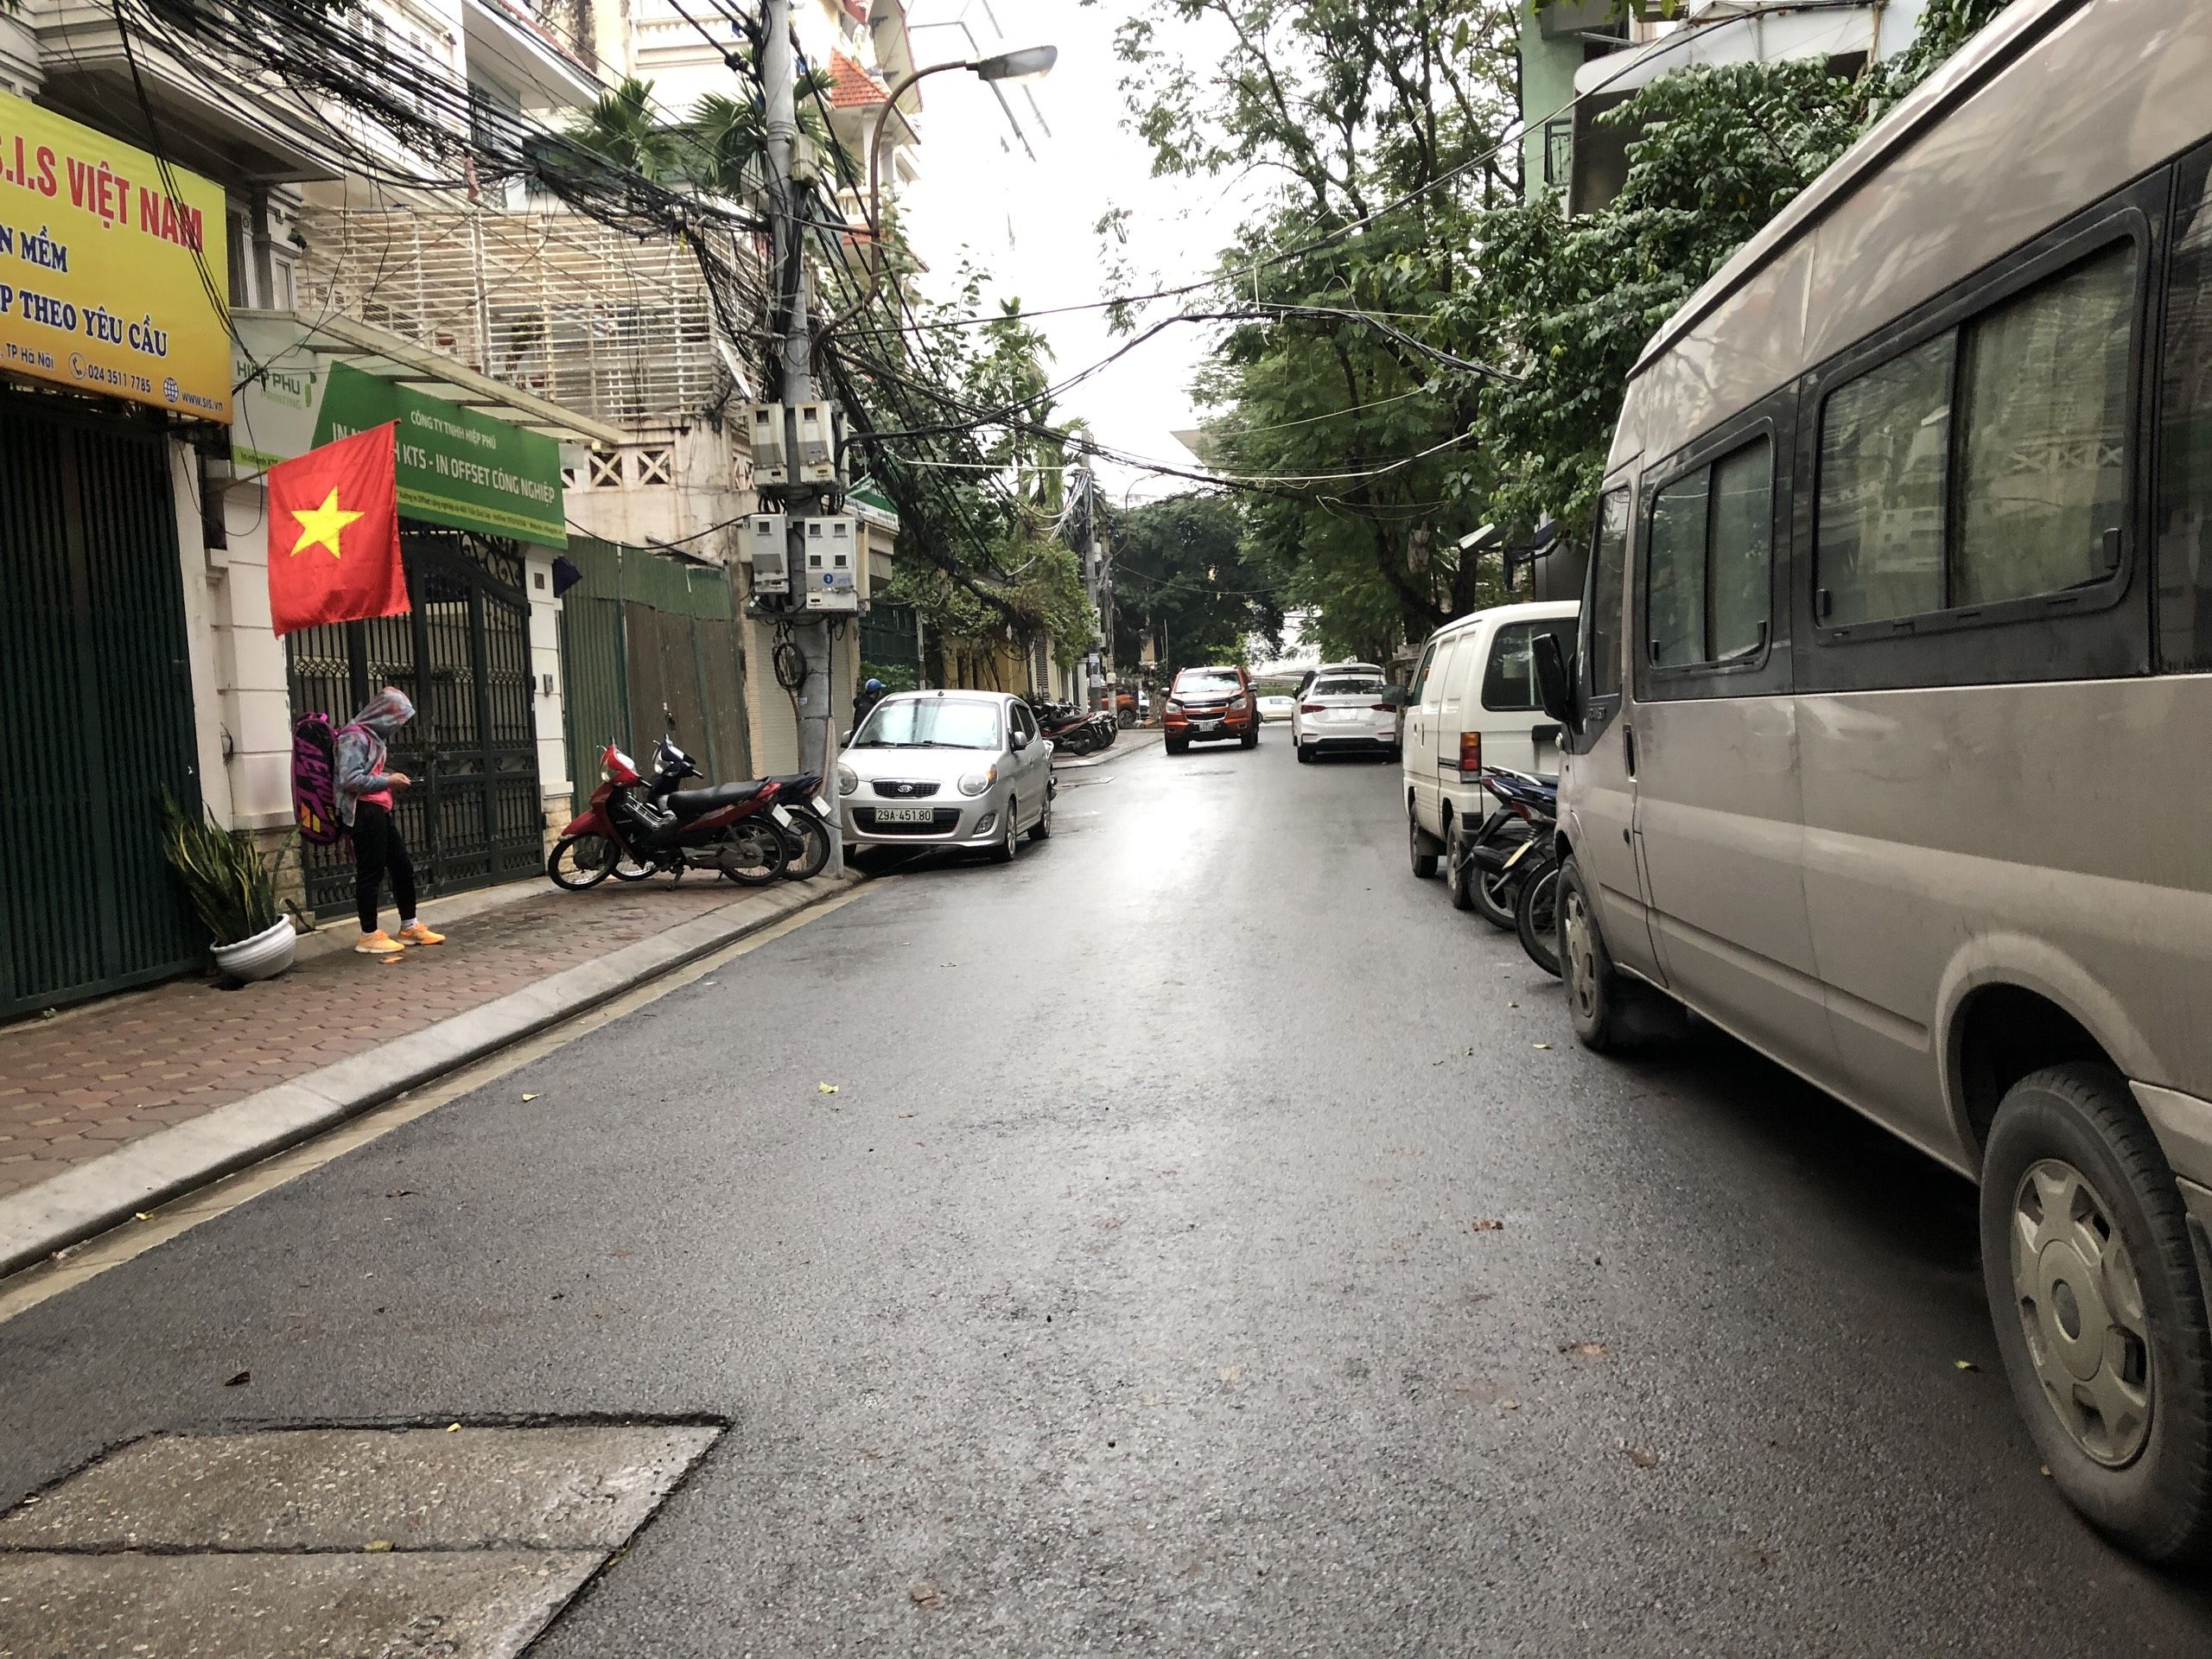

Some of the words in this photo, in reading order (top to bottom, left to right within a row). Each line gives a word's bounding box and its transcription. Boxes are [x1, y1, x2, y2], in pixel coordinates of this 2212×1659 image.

[0, 136, 57, 197] .I.S
[67, 156, 130, 229] VIỆT
[140, 187, 203, 253] NAM
[20, 225, 68, 273] MỀM
[19, 289, 77, 330] THEO
[82, 305, 123, 344] YÊU
[129, 315, 167, 357] CẦU
[6, 343, 17, 359] TP
[88, 365, 105, 381] 024
[107, 369, 127, 387] 3511
[131, 375, 151, 393] 7785
[182, 391, 223, 411] www.sis.vn
[333, 422, 346, 441] IN
[410, 410, 433, 429] CÔNG
[433, 417, 442, 433] TY
[443, 421, 465, 440] TNHH
[465, 428, 481, 446] HIỆP
[404, 443, 426, 469] KTS
[435, 454, 448, 476] IN
[451, 458, 490, 486] OFFSET
[492, 467, 518, 494] CÔNG
[520, 478, 555, 507] NGHIỆP
[878, 810, 931, 821] 29A-451.80
